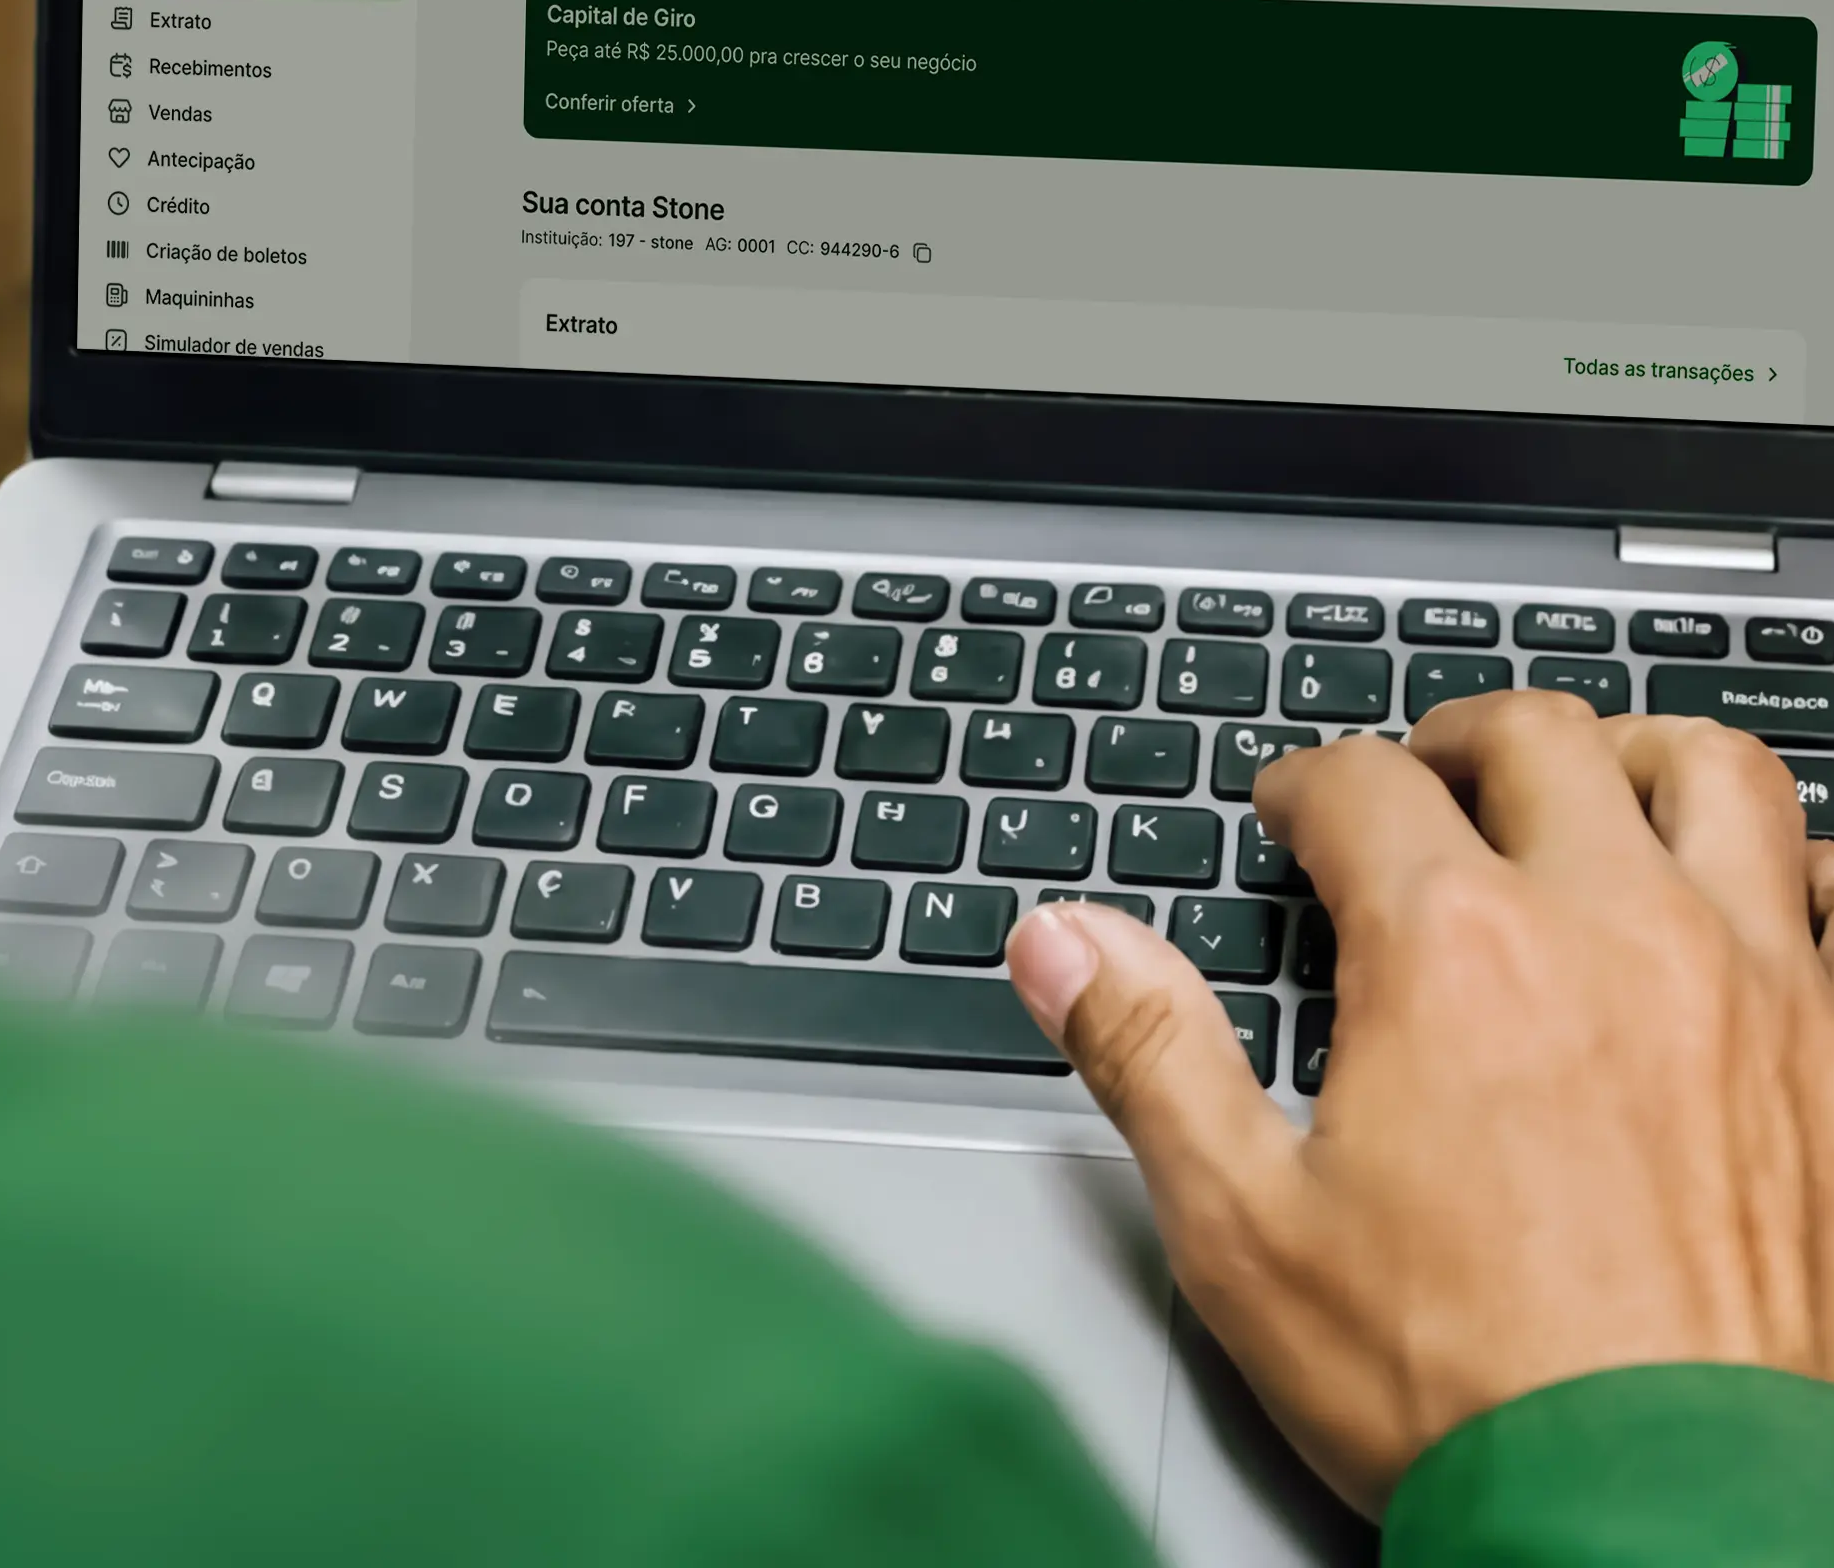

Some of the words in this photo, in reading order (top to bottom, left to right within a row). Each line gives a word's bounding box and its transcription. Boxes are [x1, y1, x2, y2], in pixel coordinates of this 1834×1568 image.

[151, 12, 211, 30] Extrato
[548, 4, 617, 29] Capital
[624, 7, 648, 27] de
[654, 8, 695, 28] Giro
[150, 58, 271, 78] Recebimentos
[547, 40, 588, 62] Peça
[595, 41, 621, 59] até
[628, 42, 649, 62] R$
[657, 43, 743, 66] 25.000,00
[750, 50, 777, 68] pra
[783, 52, 848, 67] crescer
[854, 55, 864, 68] o
[871, 55, 900, 69] seu
[908, 52, 976, 75] negócio
[149, 104, 212, 123] Vendas
[546, 93, 616, 112] Conferir
[622, 95, 673, 114] oferta
[148, 150, 255, 173] Antecipação
[147, 196, 209, 215] Crédito
[523, 190, 568, 215] Sua
[576, 195, 644, 218] conta
[653, 195, 724, 221] Stone
[147, 242, 211, 264] Criação
[217, 246, 238, 262] de
[244, 246, 306, 265] boletos
[522, 230, 601, 250] Instituição:
[609, 233, 634, 248] 197
[652, 236, 693, 251] stone
[706, 236, 731, 252] AG:
[738, 238, 774, 254] 0001
[787, 239, 813, 255] CC:
[821, 242, 899, 259] 944290-6
[146, 288, 254, 310] Maquininhas
[547, 313, 617, 334] Extrato
[145, 334, 230, 354] Simulador
[236, 339, 256, 355] de
[263, 341, 324, 358] vendas
[1564, 357, 1619, 377] Todas
[1625, 363, 1645, 378] as
[1651, 362, 1754, 385] transações
[492, 694, 518, 716] E
[378, 774, 405, 800] S
[623, 784, 648, 815] F
[748, 794, 779, 819] G
[1132, 814, 1158, 841] K
[794, 883, 821, 909] B
[925, 892, 955, 919] N
